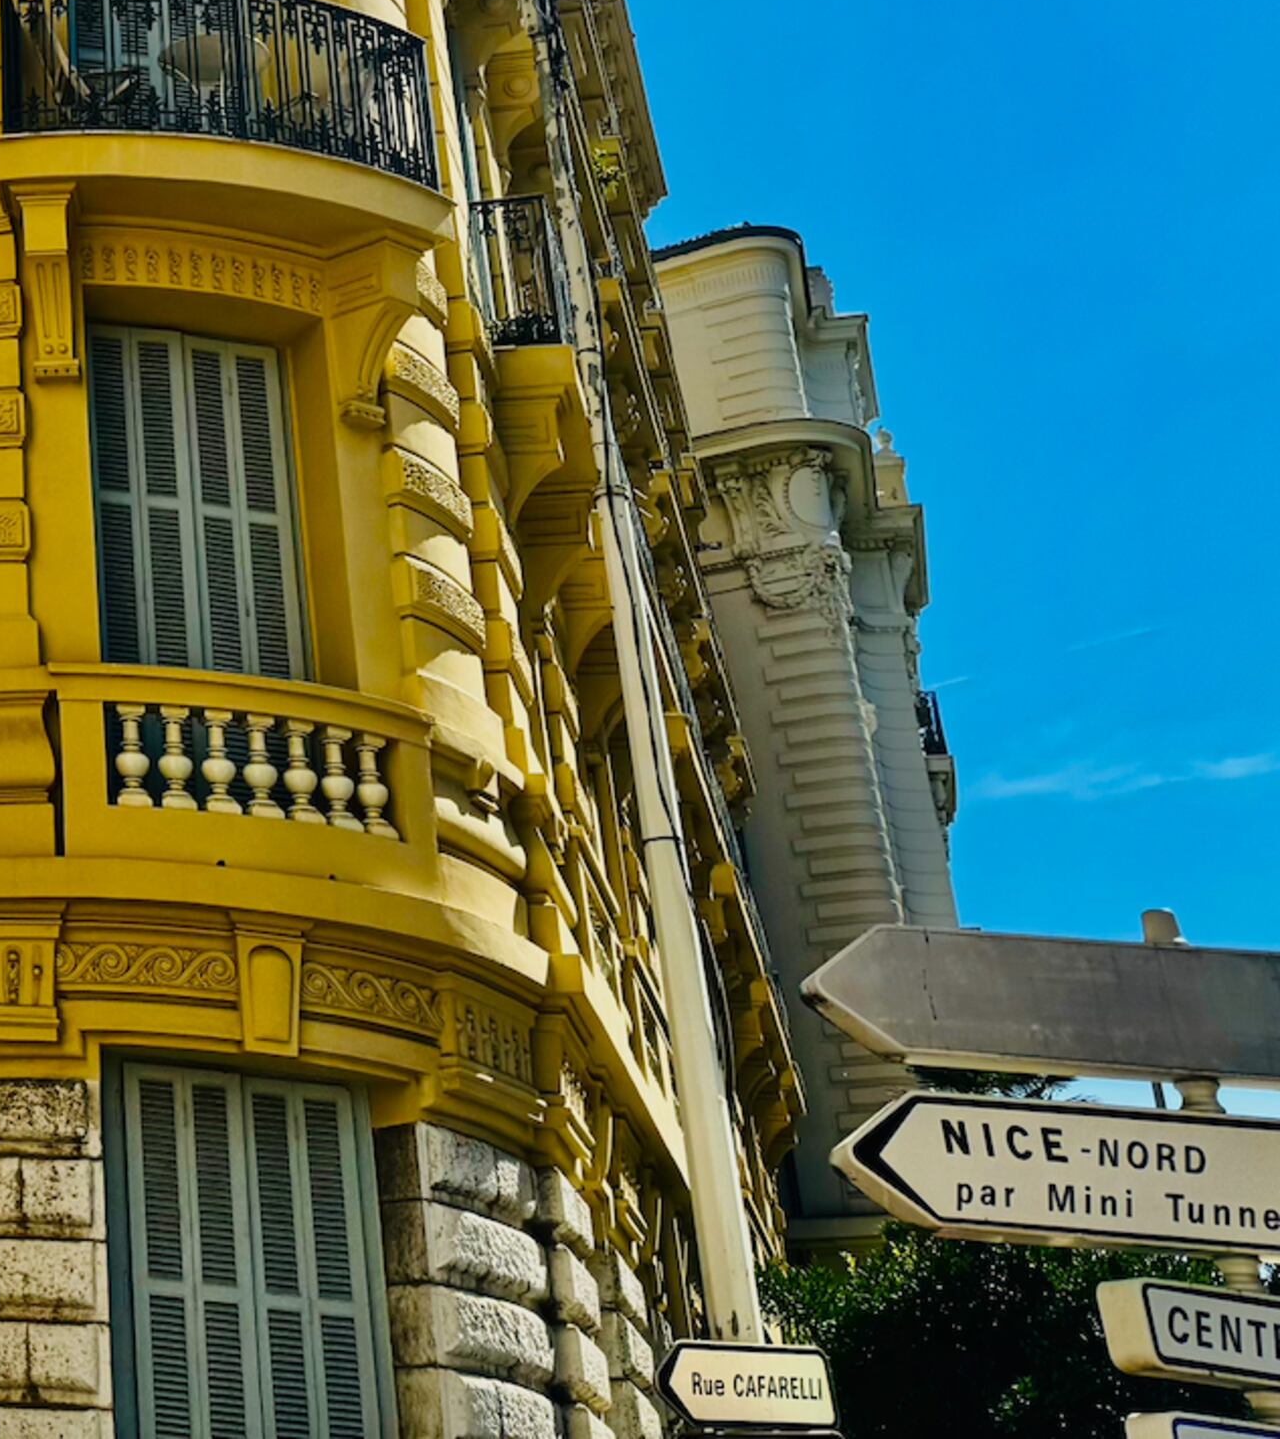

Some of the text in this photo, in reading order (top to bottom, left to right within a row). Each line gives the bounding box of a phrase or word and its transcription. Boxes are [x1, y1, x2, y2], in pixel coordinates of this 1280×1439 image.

[956, 1182, 1015, 1211] par
[1048, 1183, 1133, 1218] Mini
[692, 1372, 822, 1400] Rue CAFARELLI
